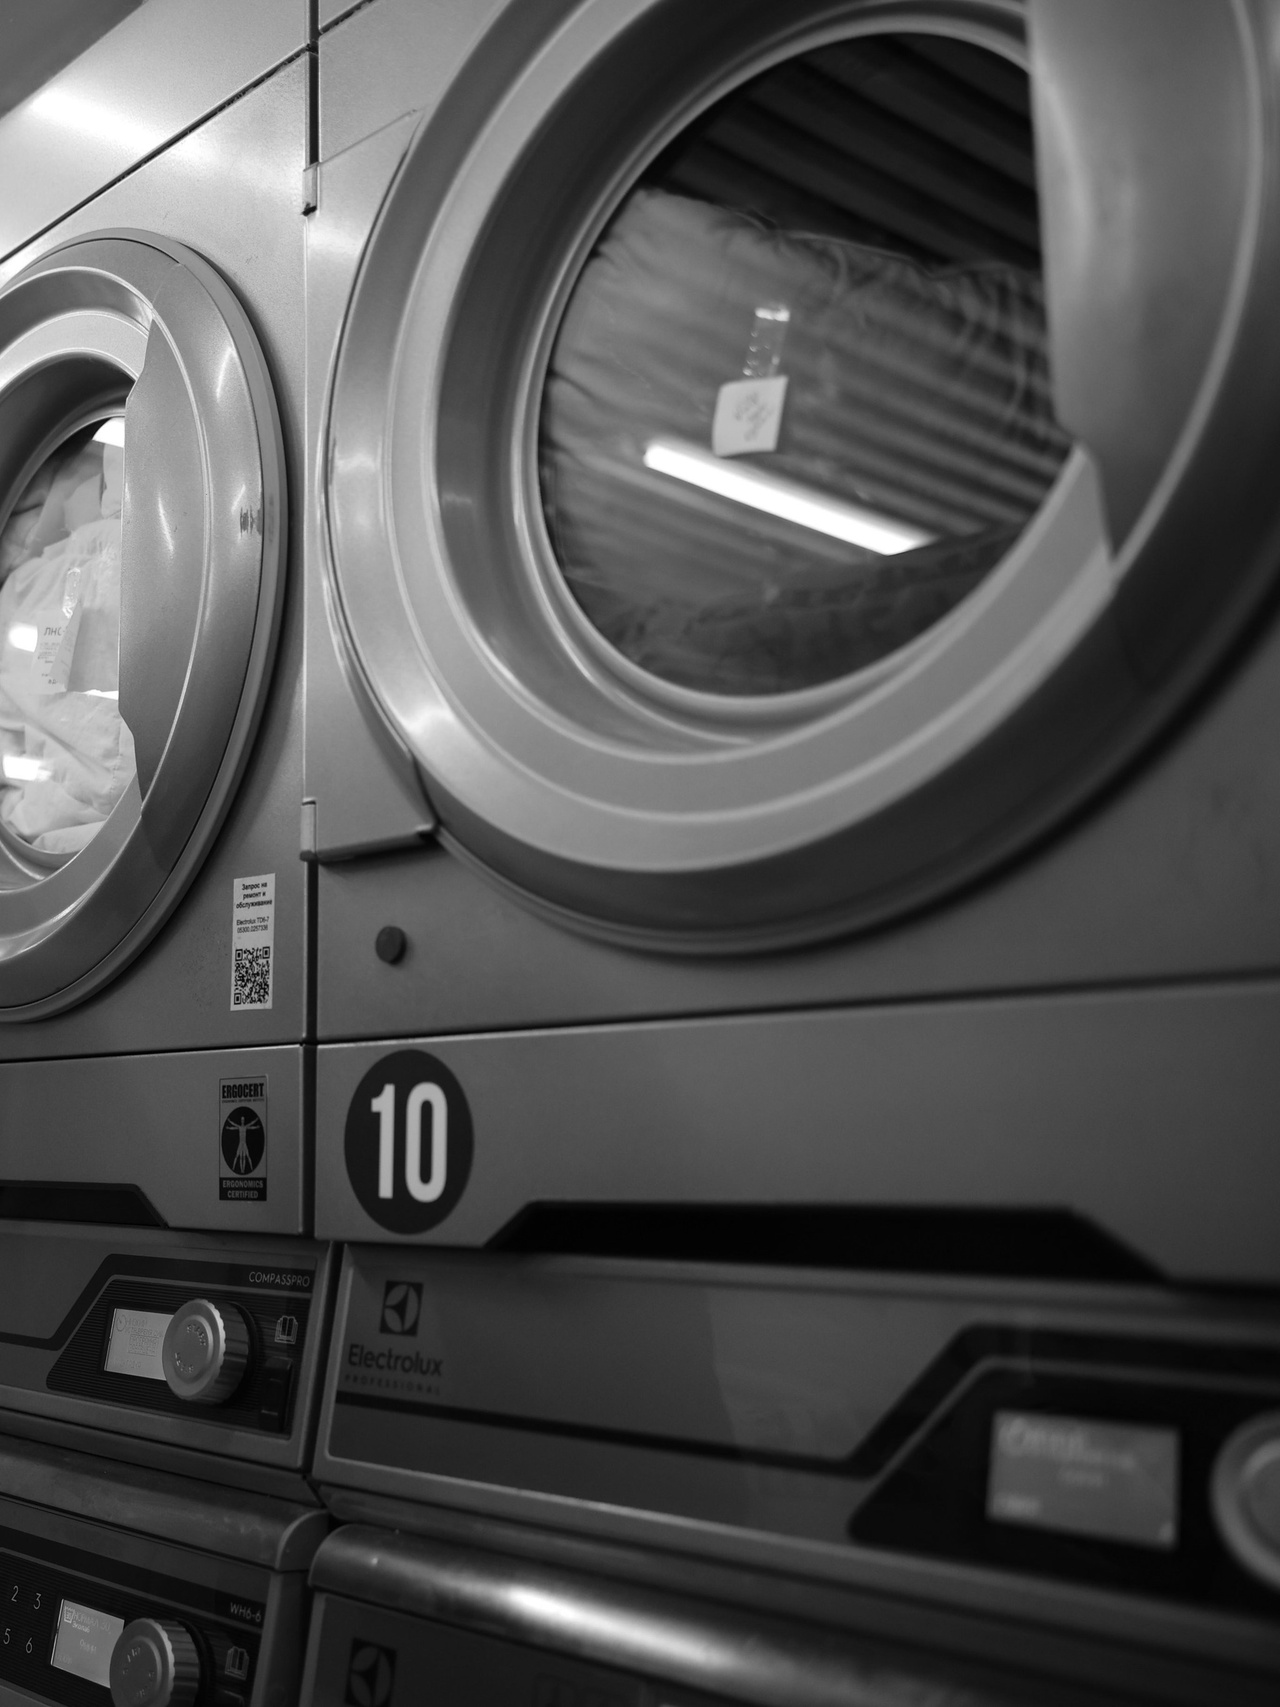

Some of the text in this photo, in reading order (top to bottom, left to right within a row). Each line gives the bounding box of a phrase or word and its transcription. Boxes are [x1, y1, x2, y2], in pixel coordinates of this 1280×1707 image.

[242, 883, 260, 891] Запрос
[236, 899, 272, 909] обслуживание
[243, 892, 261, 900] ремонт
[237, 918, 256, 926] Electrolux
[222, 1083, 264, 1099] ERGOCERT
[371, 1081, 448, 1203] 10
[222, 1179, 263, 1188] ERGONOMICS
[227, 1190, 258, 1198] CERTIFIED
[249, 1271, 310, 1287] COMPASSPRO
[348, 1344, 444, 1377] Electrolux
[345, 1374, 441, 1396] PROFESSIONAL
[11, 1585, 20, 1602] 2
[33, 1593, 42, 1610] 3
[230, 1602, 263, 1623] WH6-6
[3, 1628, 11, 1645] 5
[25, 1637, 33, 1654] 6
